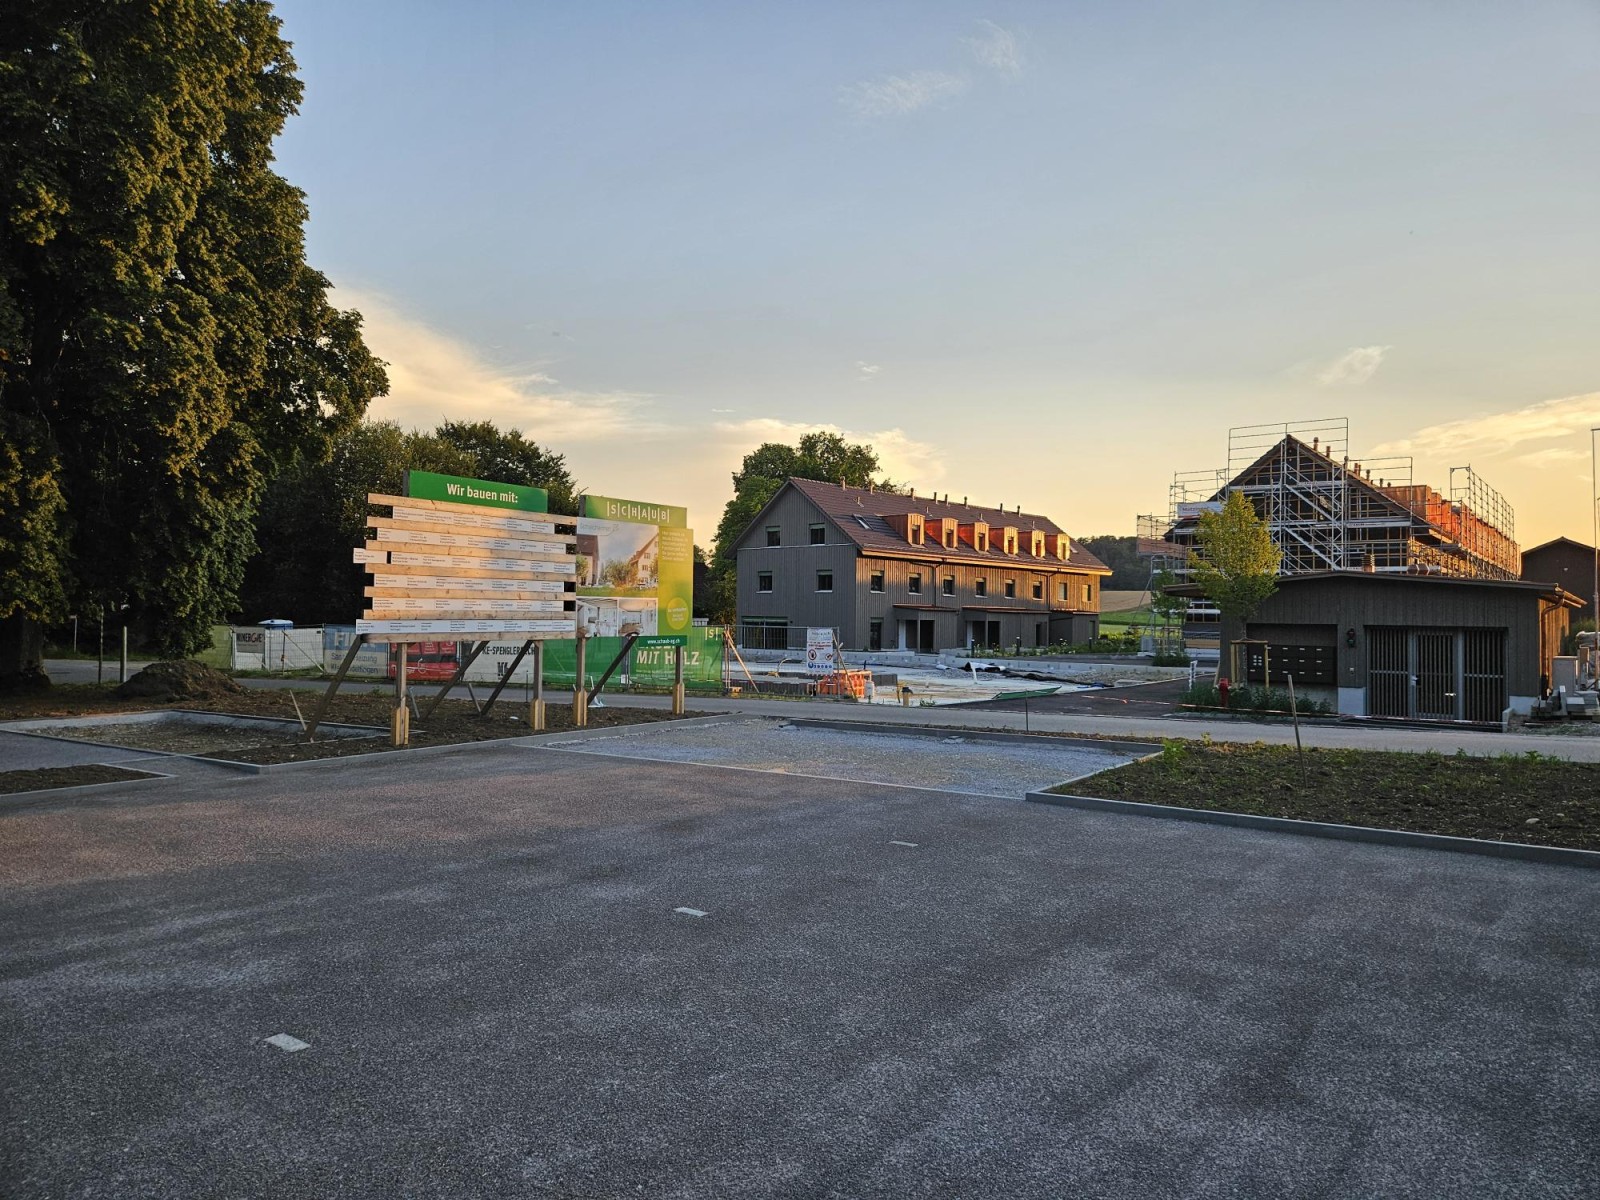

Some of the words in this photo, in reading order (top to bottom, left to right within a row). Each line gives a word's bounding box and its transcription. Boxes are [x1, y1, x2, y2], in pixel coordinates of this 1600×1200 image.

[446, 483, 465, 496] Wir
[466, 486, 497, 500] bauen
[499, 491, 518, 503] mit:
[608, 502, 669, 522] SCHAUB
[636, 650, 660, 664] MIT
